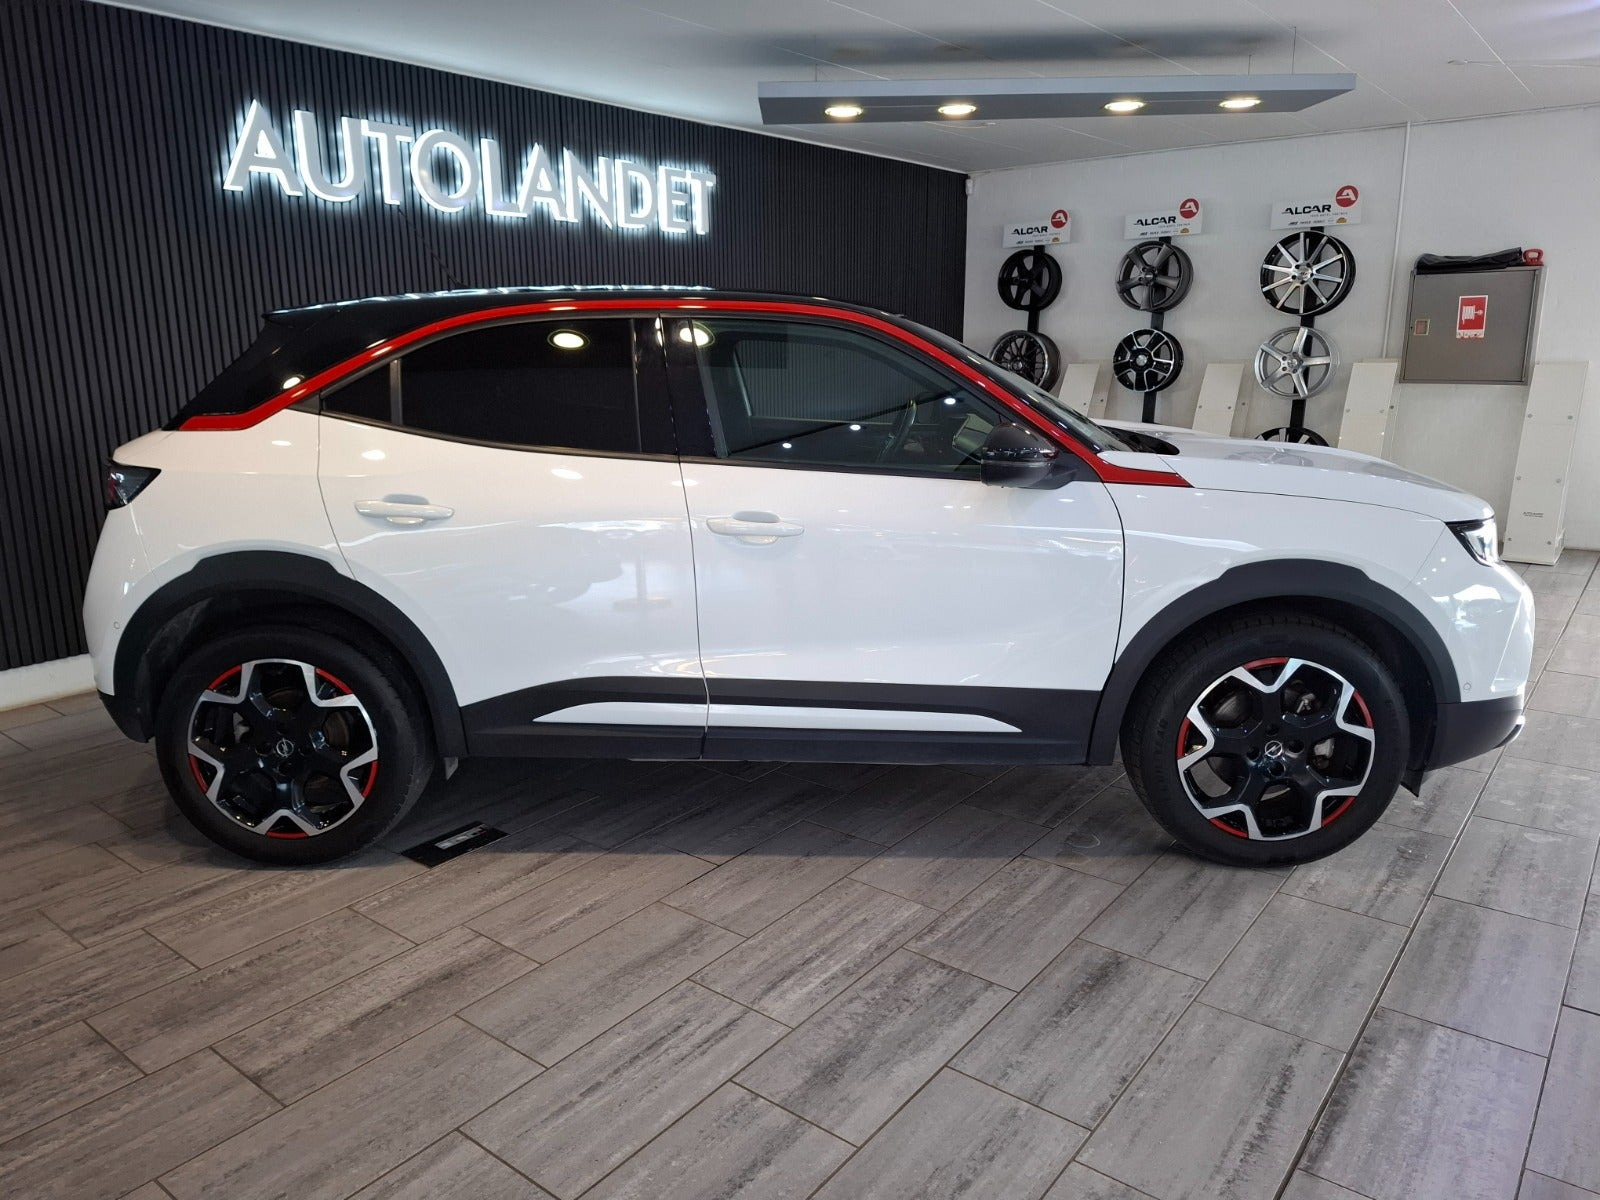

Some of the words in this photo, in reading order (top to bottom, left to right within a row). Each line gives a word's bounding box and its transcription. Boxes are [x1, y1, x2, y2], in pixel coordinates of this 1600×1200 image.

[223, 99, 716, 235] AUTOLANDET
[1281, 204, 1332, 215] ALCAR
[1133, 215, 1177, 227] ALCAR
[1011, 225, 1048, 236] ALCAR
